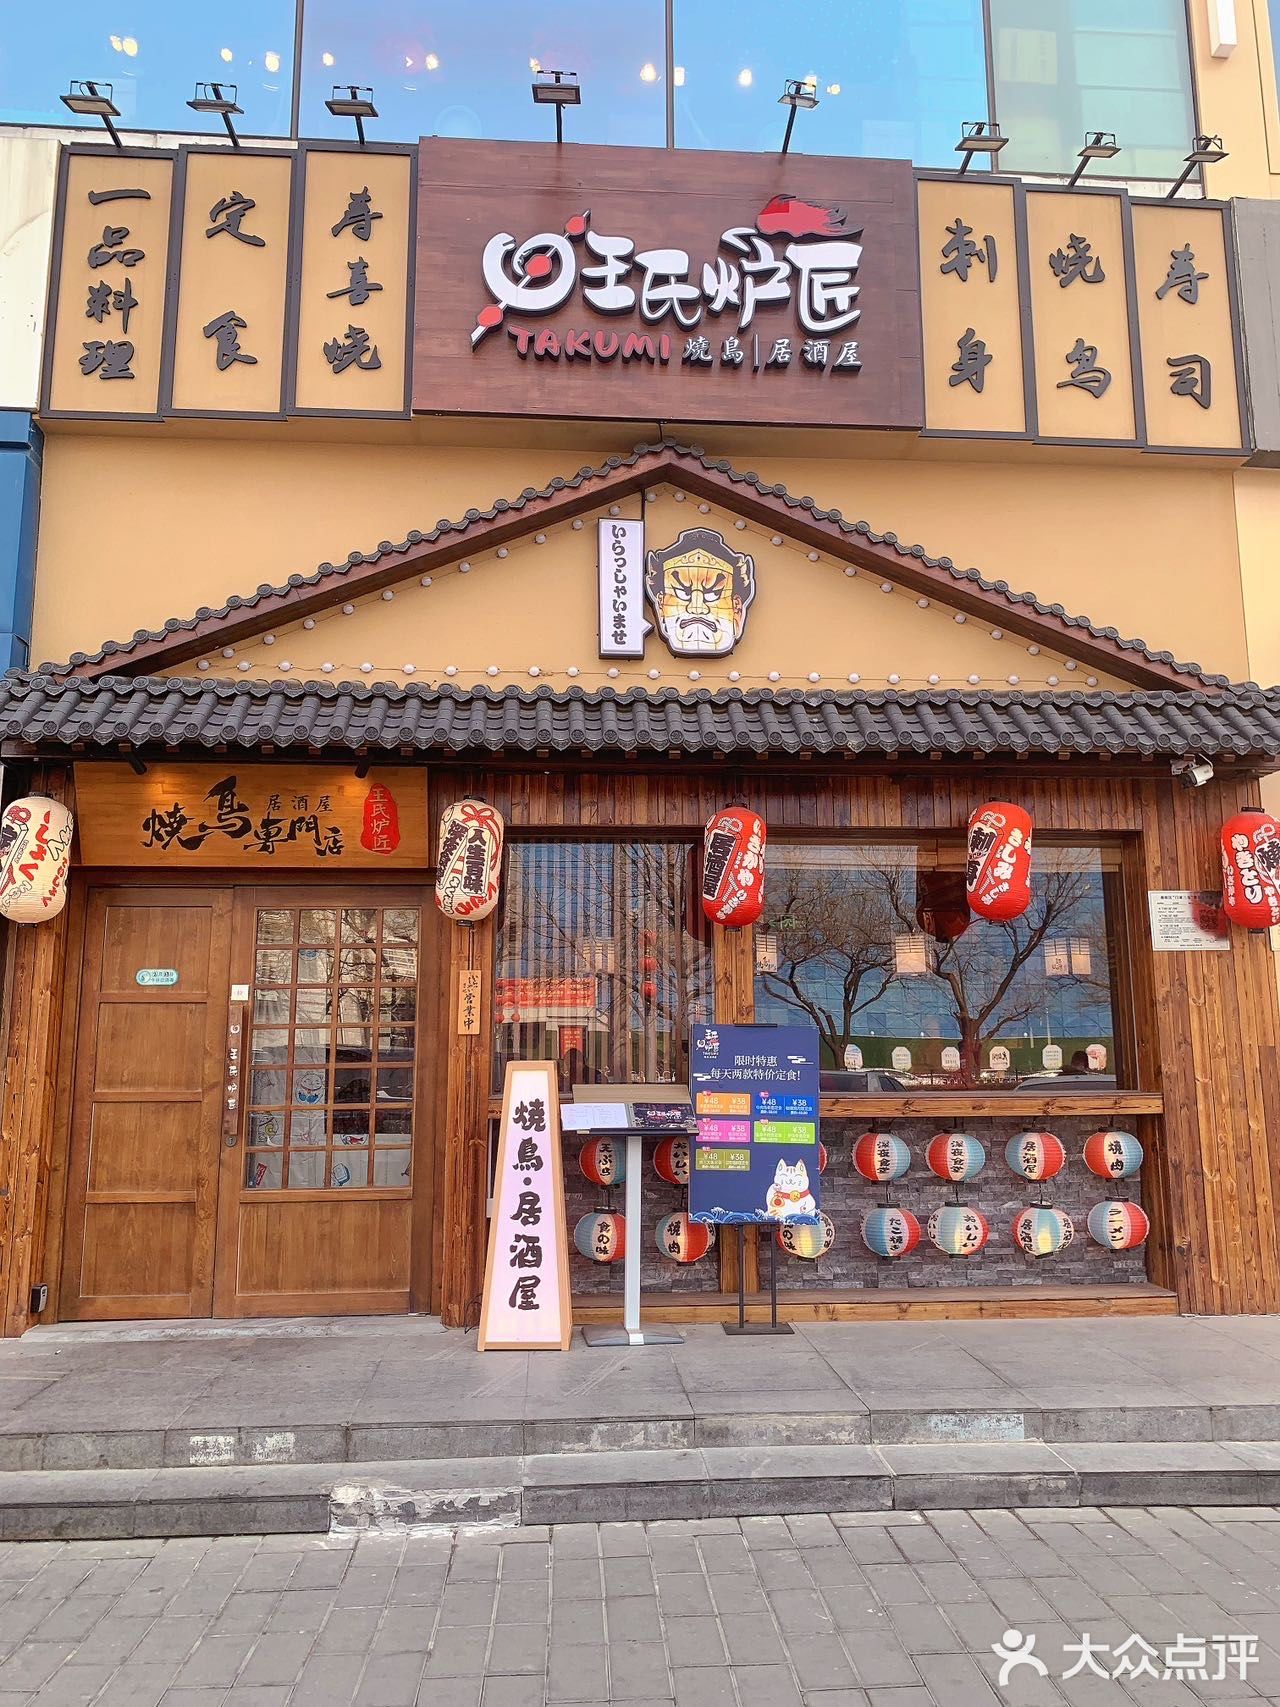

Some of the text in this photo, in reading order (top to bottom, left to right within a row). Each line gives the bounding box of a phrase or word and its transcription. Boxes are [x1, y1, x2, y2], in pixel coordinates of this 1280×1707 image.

[78, 188, 151, 380] 一品料理
[203, 191, 266, 371] 定食
[323, 186, 383, 375] 寿喜烧
[940, 218, 998, 393] 刺身
[1049, 233, 1111, 398] 烧鸟
[1156, 243, 1211, 409] 寿司
[508, 325, 671, 361] TAKUMI
[768, 338, 863, 367] 居酒屋
[612, 525, 627, 645] いらっしゃいませ
[266, 794, 333, 813] 居酒屋
[463, 829, 486, 894] 人生百味
[993, 828, 1023, 880] さしみ
[1231, 833, 1264, 905] やきとり
[711, 1067, 801, 1081] 每天两款特价定食!
[734, 1055, 778, 1067] 限时特惠
[792, 1099, 807, 1107] ¥38
[704, 1124, 718, 1132] ¥48
[703, 1152, 745, 1161] ¥48 ¥38
[1023, 1141, 1037, 1174] 居酒屋
[961, 1214, 979, 1248] おいしい
[1107, 1208, 1124, 1242] ラーメン
